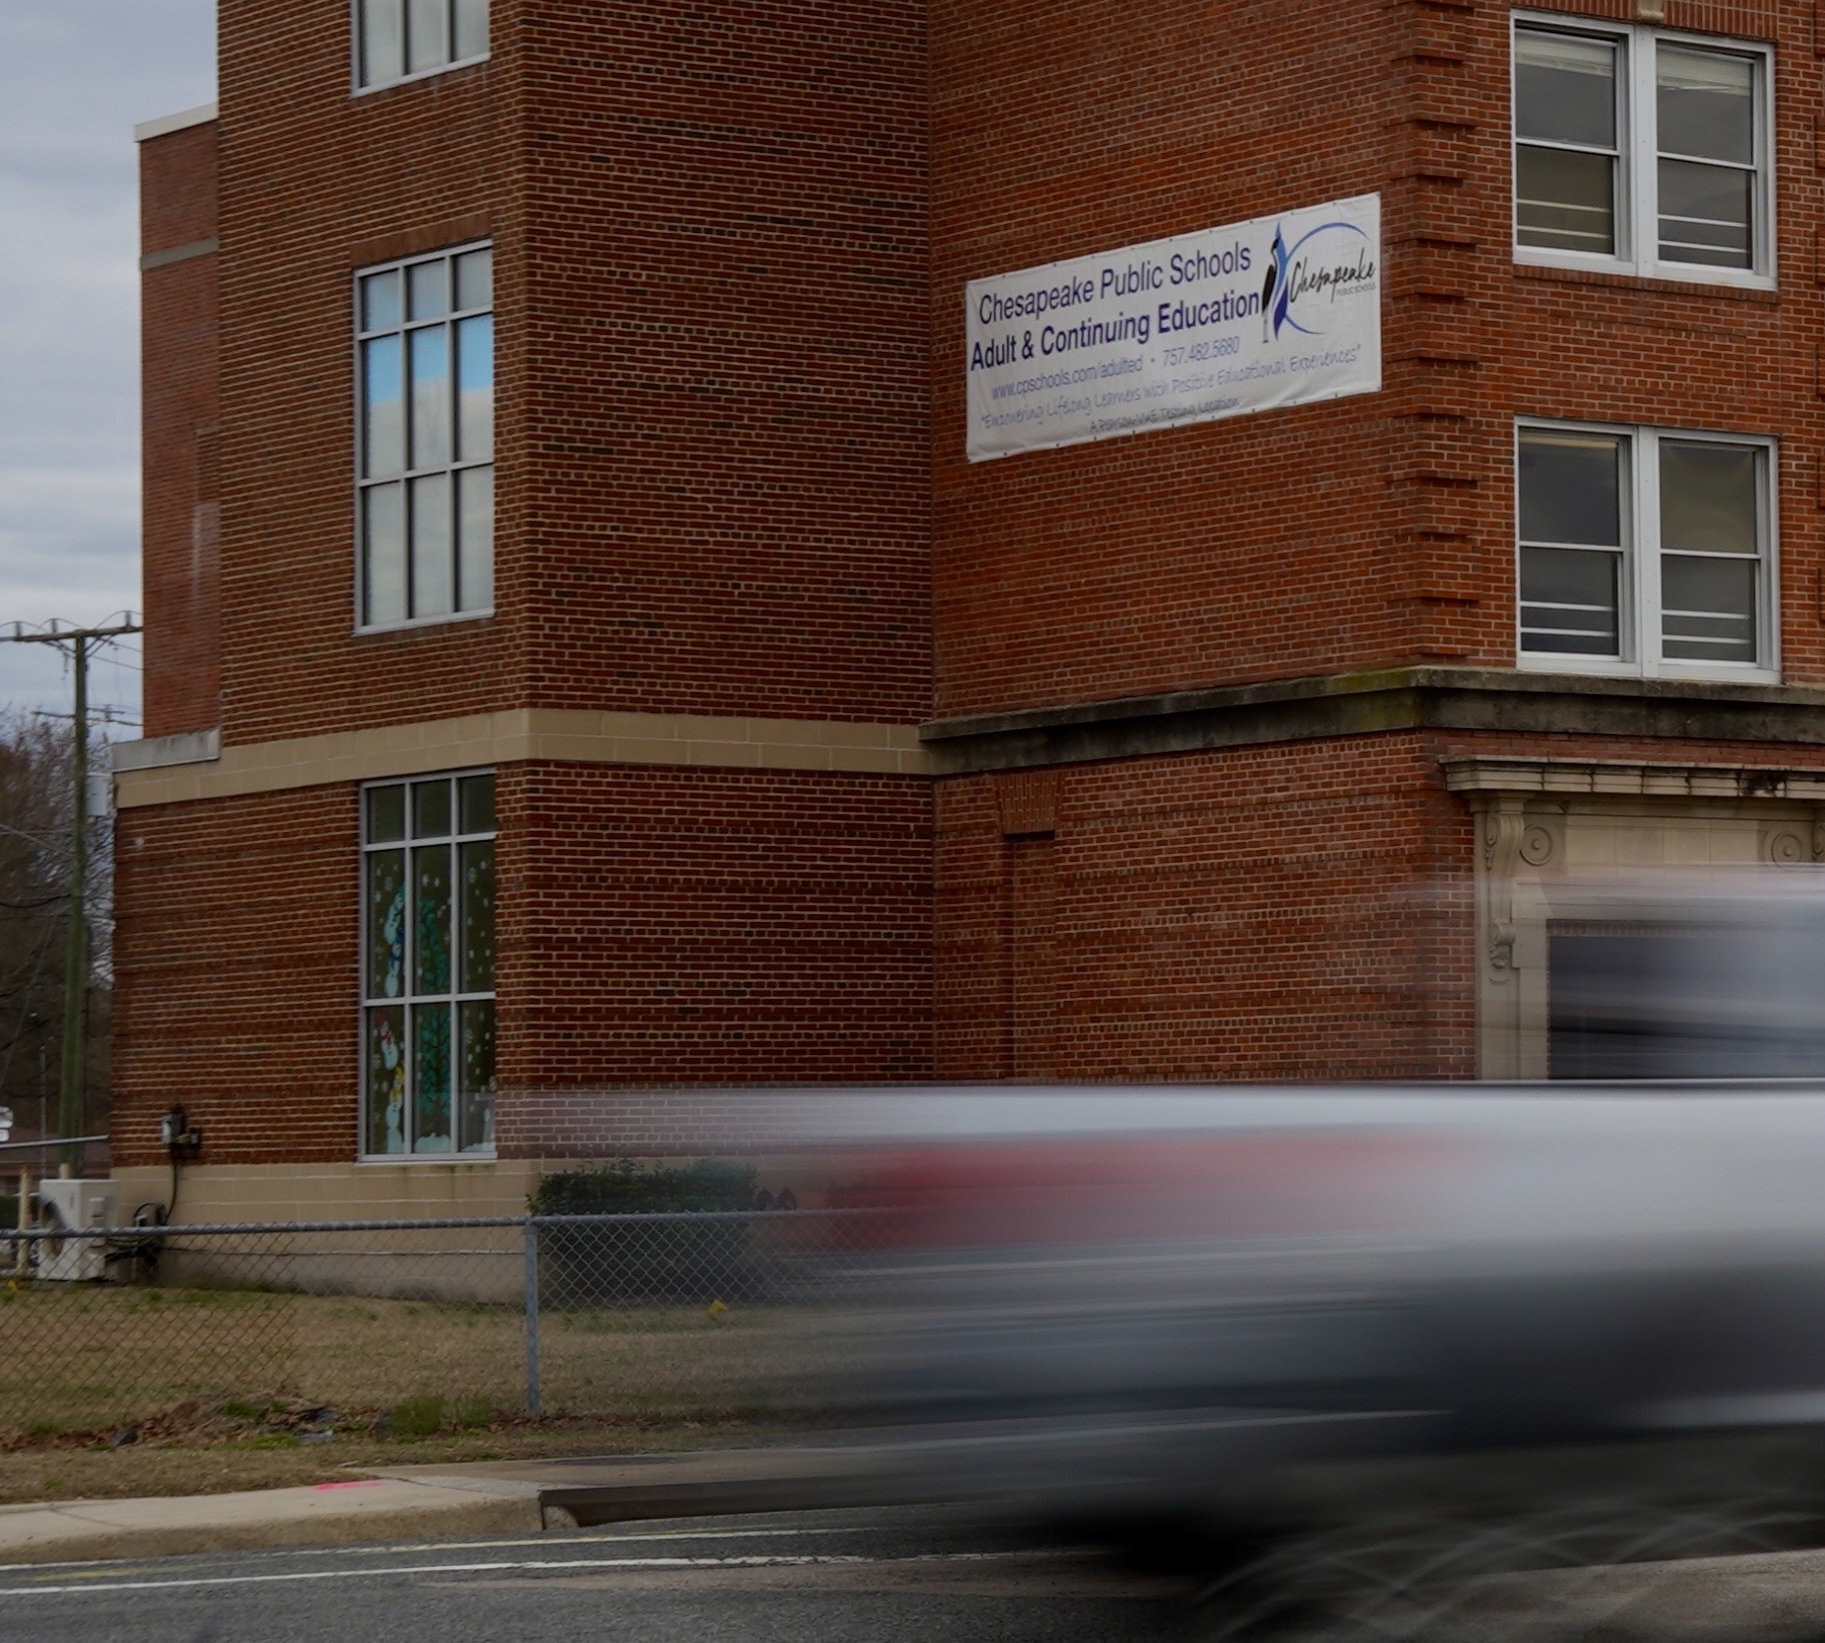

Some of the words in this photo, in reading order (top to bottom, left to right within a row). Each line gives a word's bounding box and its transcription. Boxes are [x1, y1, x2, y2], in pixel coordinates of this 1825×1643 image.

[979, 275, 1094, 324] Chesapeake
[1100, 261, 1163, 299] Public
[1170, 241, 1251, 285] Schools
[1289, 246, 1377, 304] Chesapeake
[970, 332, 1017, 372] Adult
[1021, 329, 1035, 360] &
[1040, 311, 1150, 356] Continuing
[1157, 289, 1260, 334] Education
